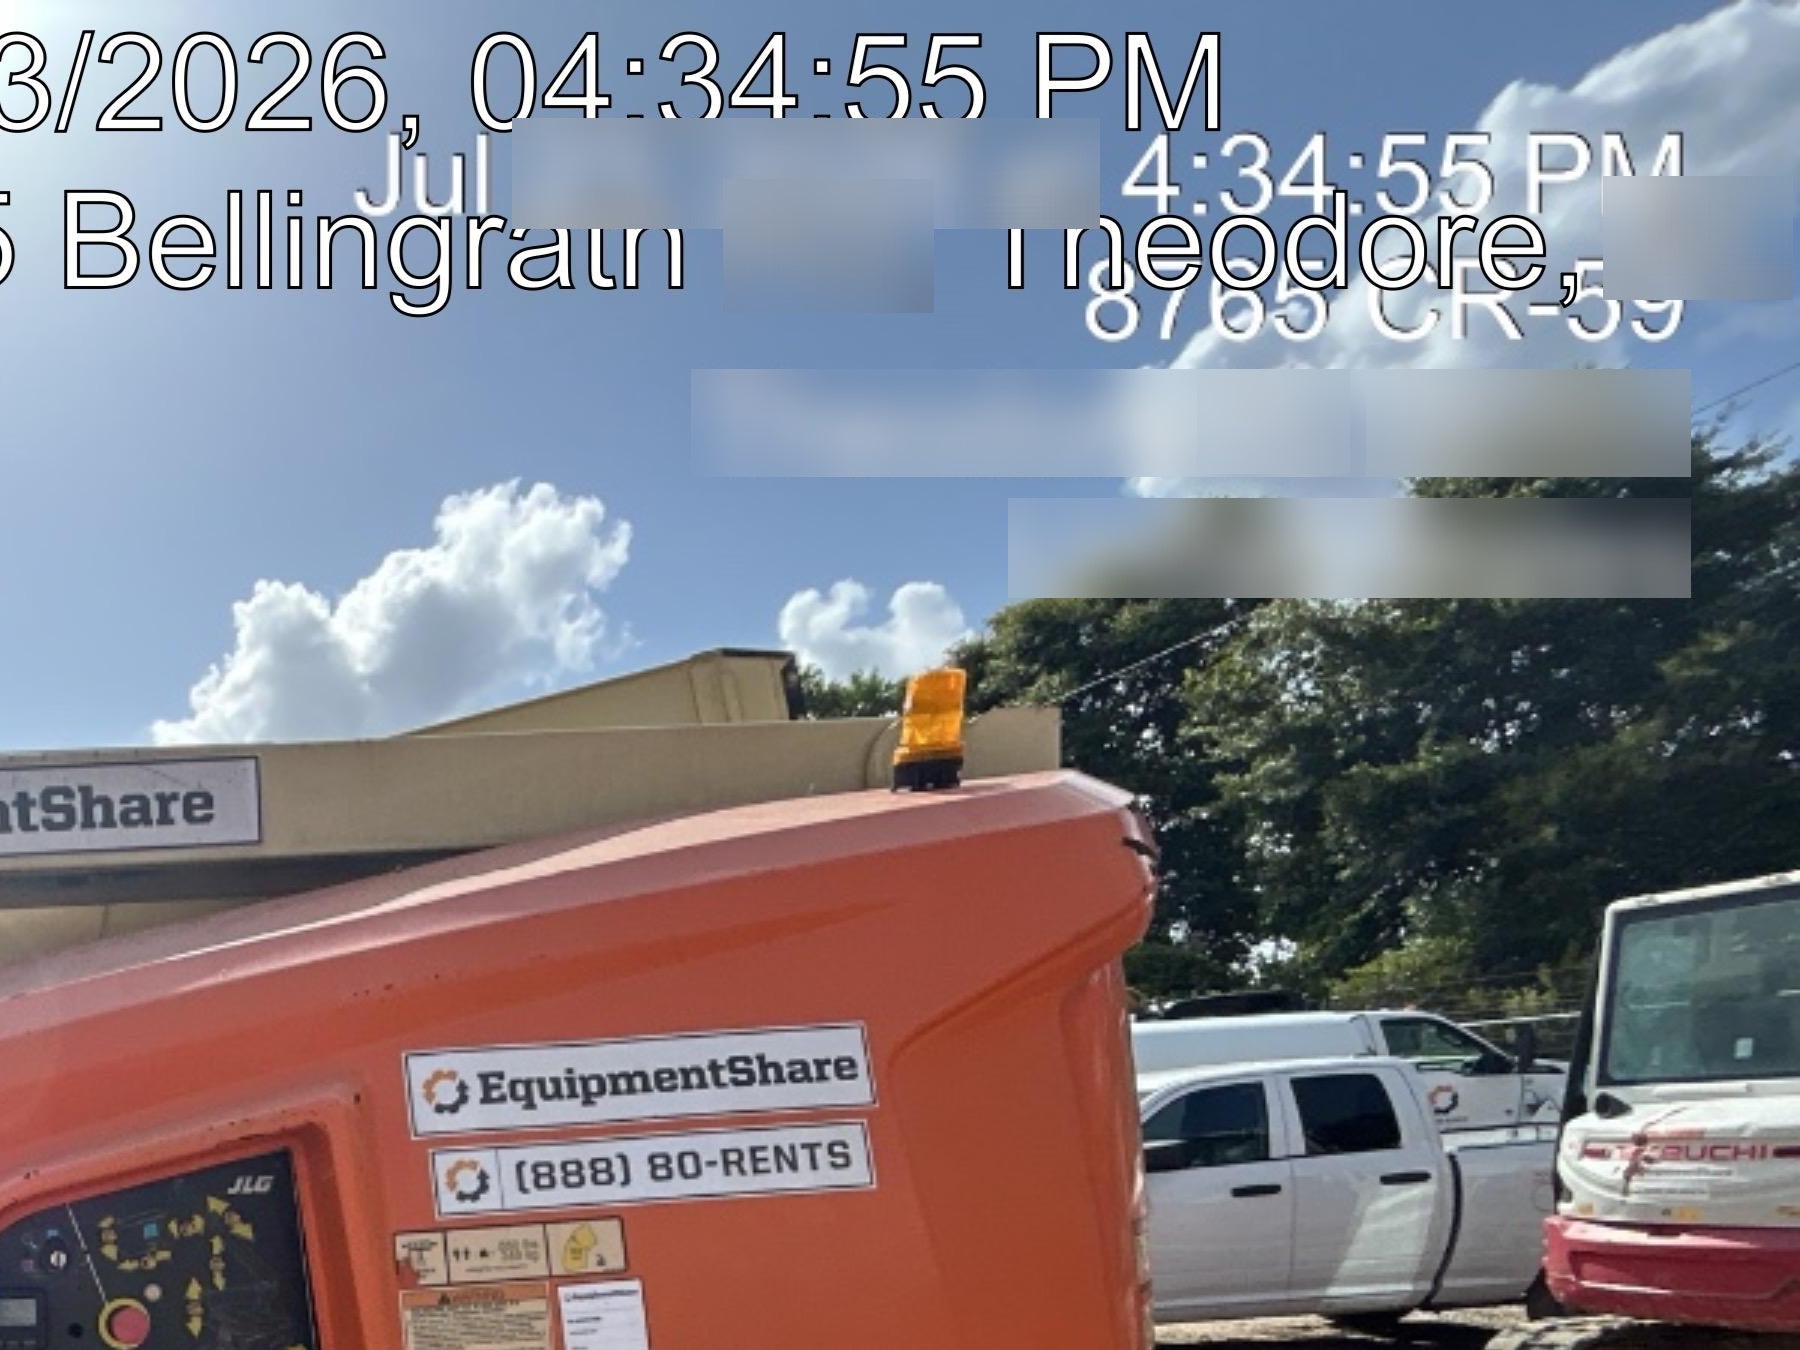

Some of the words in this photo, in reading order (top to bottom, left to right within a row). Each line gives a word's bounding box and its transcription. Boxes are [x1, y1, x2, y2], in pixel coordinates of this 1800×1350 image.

[477, 1053, 859, 1110] EquipmentShare
[227, 1175, 274, 1195] JLG
[515, 1154, 632, 1194] (888)
[648, 1140, 852, 1181] 80-RENTS
